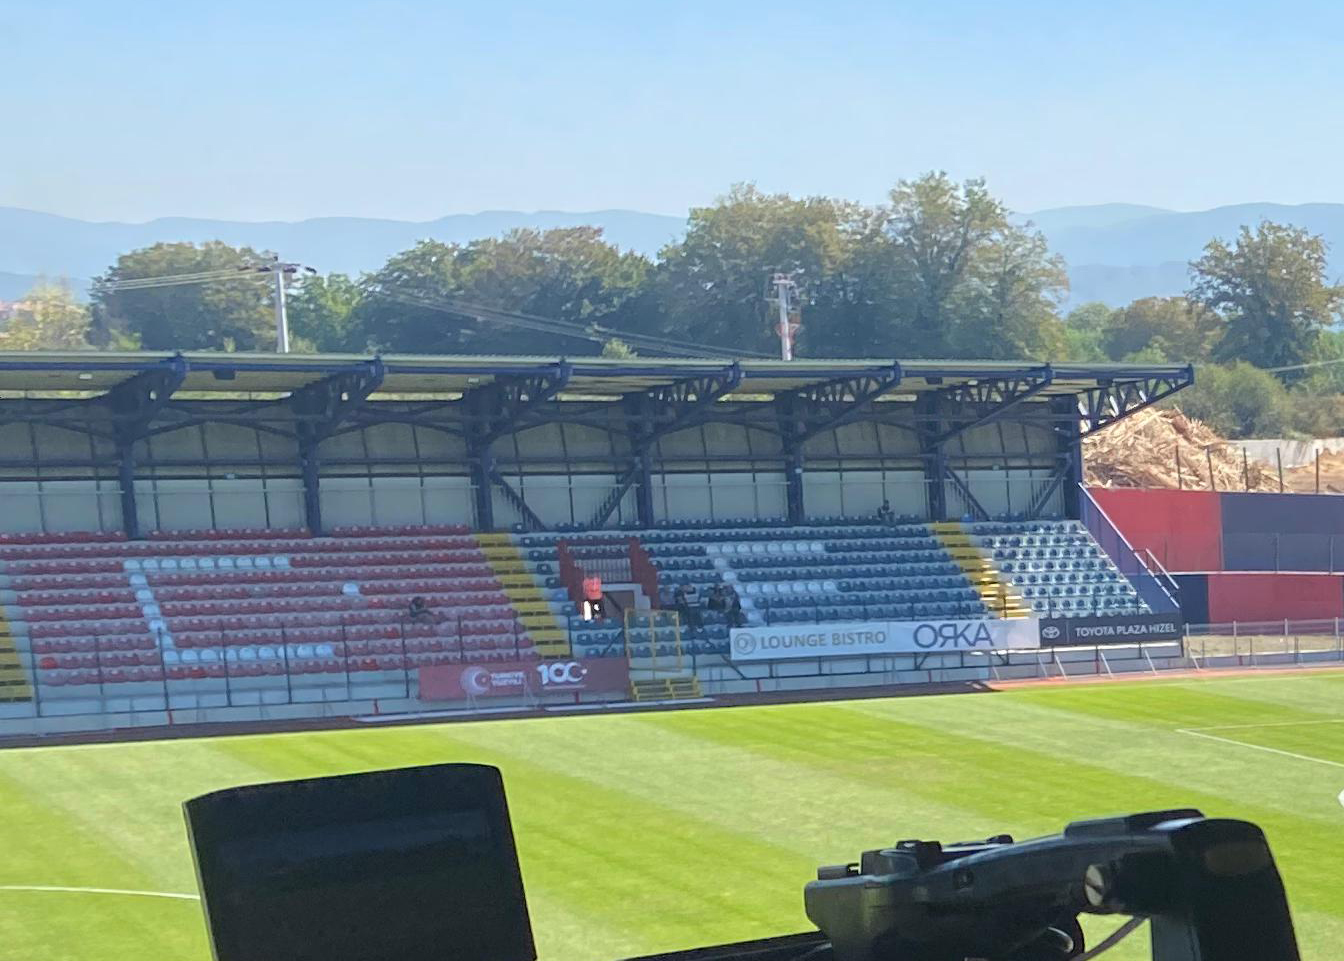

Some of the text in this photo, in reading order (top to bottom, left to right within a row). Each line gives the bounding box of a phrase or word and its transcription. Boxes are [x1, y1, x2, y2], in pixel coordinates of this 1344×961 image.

[1075, 626, 1115, 637] TOYOTA
[1116, 624, 1148, 635] PLAZA
[760, 632, 827, 649] LOUNGE
